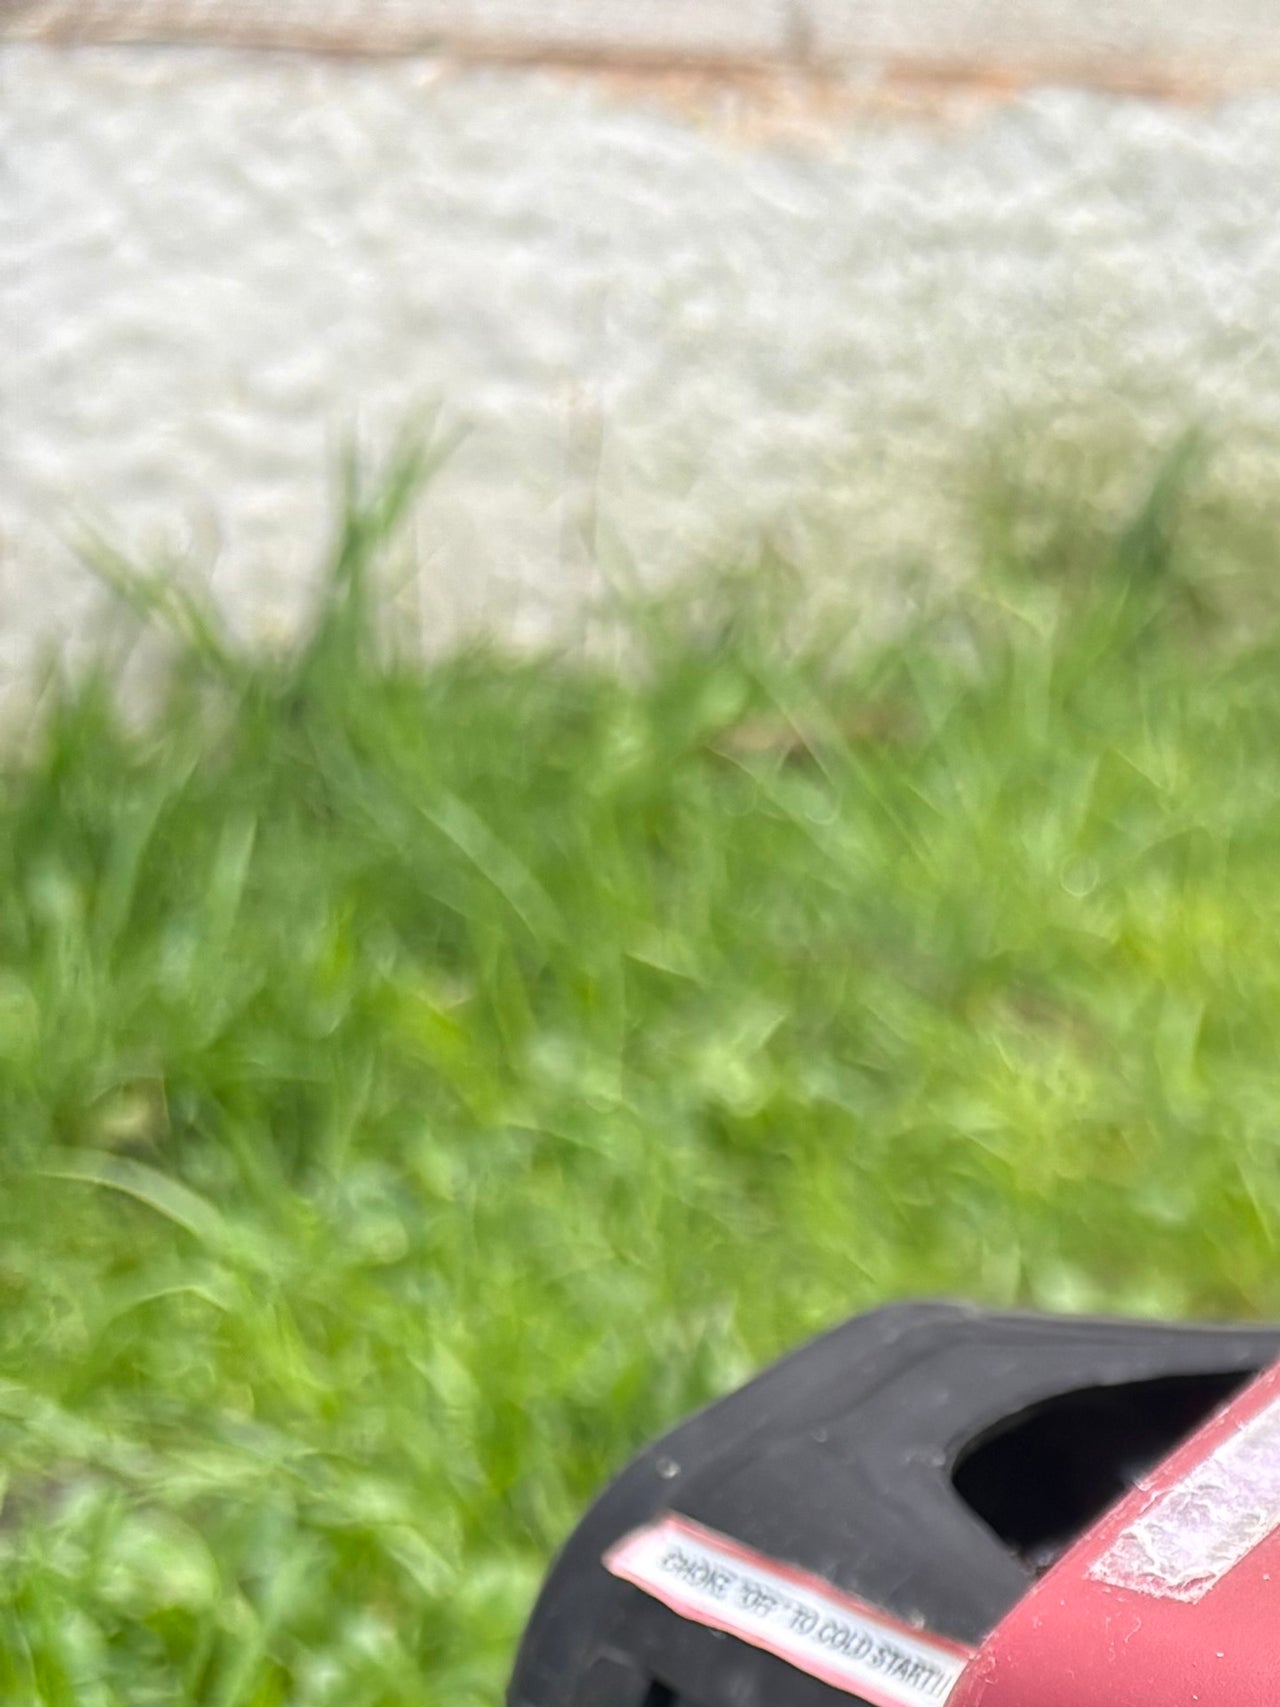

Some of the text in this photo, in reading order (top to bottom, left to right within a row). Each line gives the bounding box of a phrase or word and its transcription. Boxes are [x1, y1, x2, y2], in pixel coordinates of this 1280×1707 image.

[659, 1545, 731, 1602] CHOKE
[790, 1604, 819, 1636] TO
[818, 1619, 873, 1660] COLD
